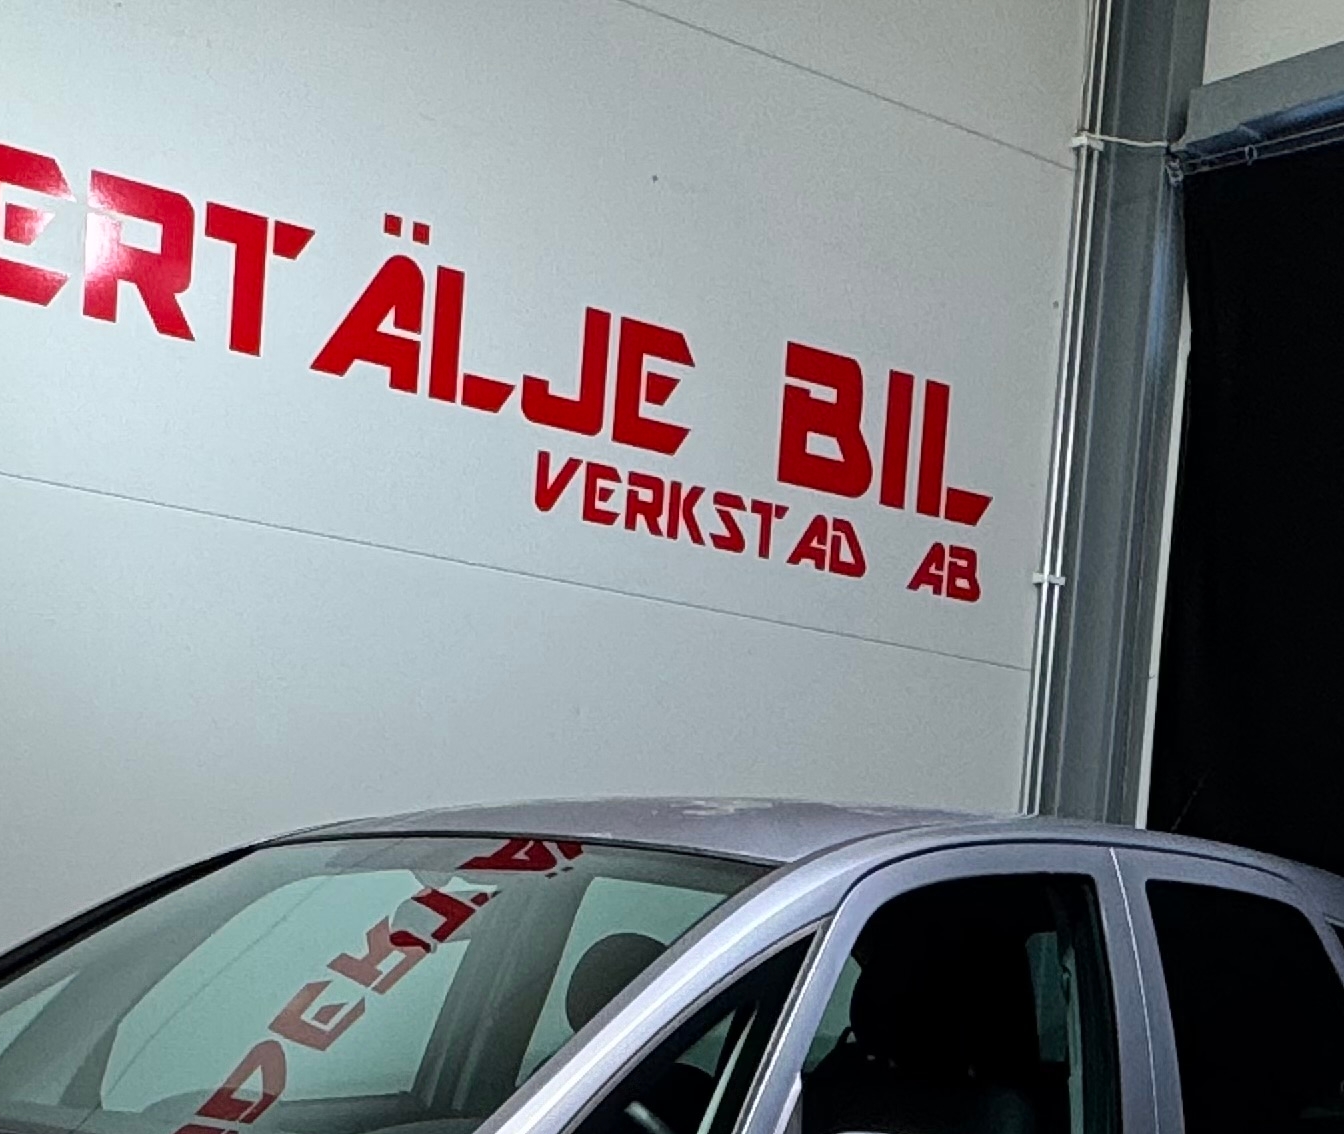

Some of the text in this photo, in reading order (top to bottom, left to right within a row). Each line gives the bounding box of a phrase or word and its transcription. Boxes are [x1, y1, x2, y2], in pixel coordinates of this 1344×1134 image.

[776, 340, 993, 527] BIL
[533, 450, 982, 603] VERKSTAD AB
